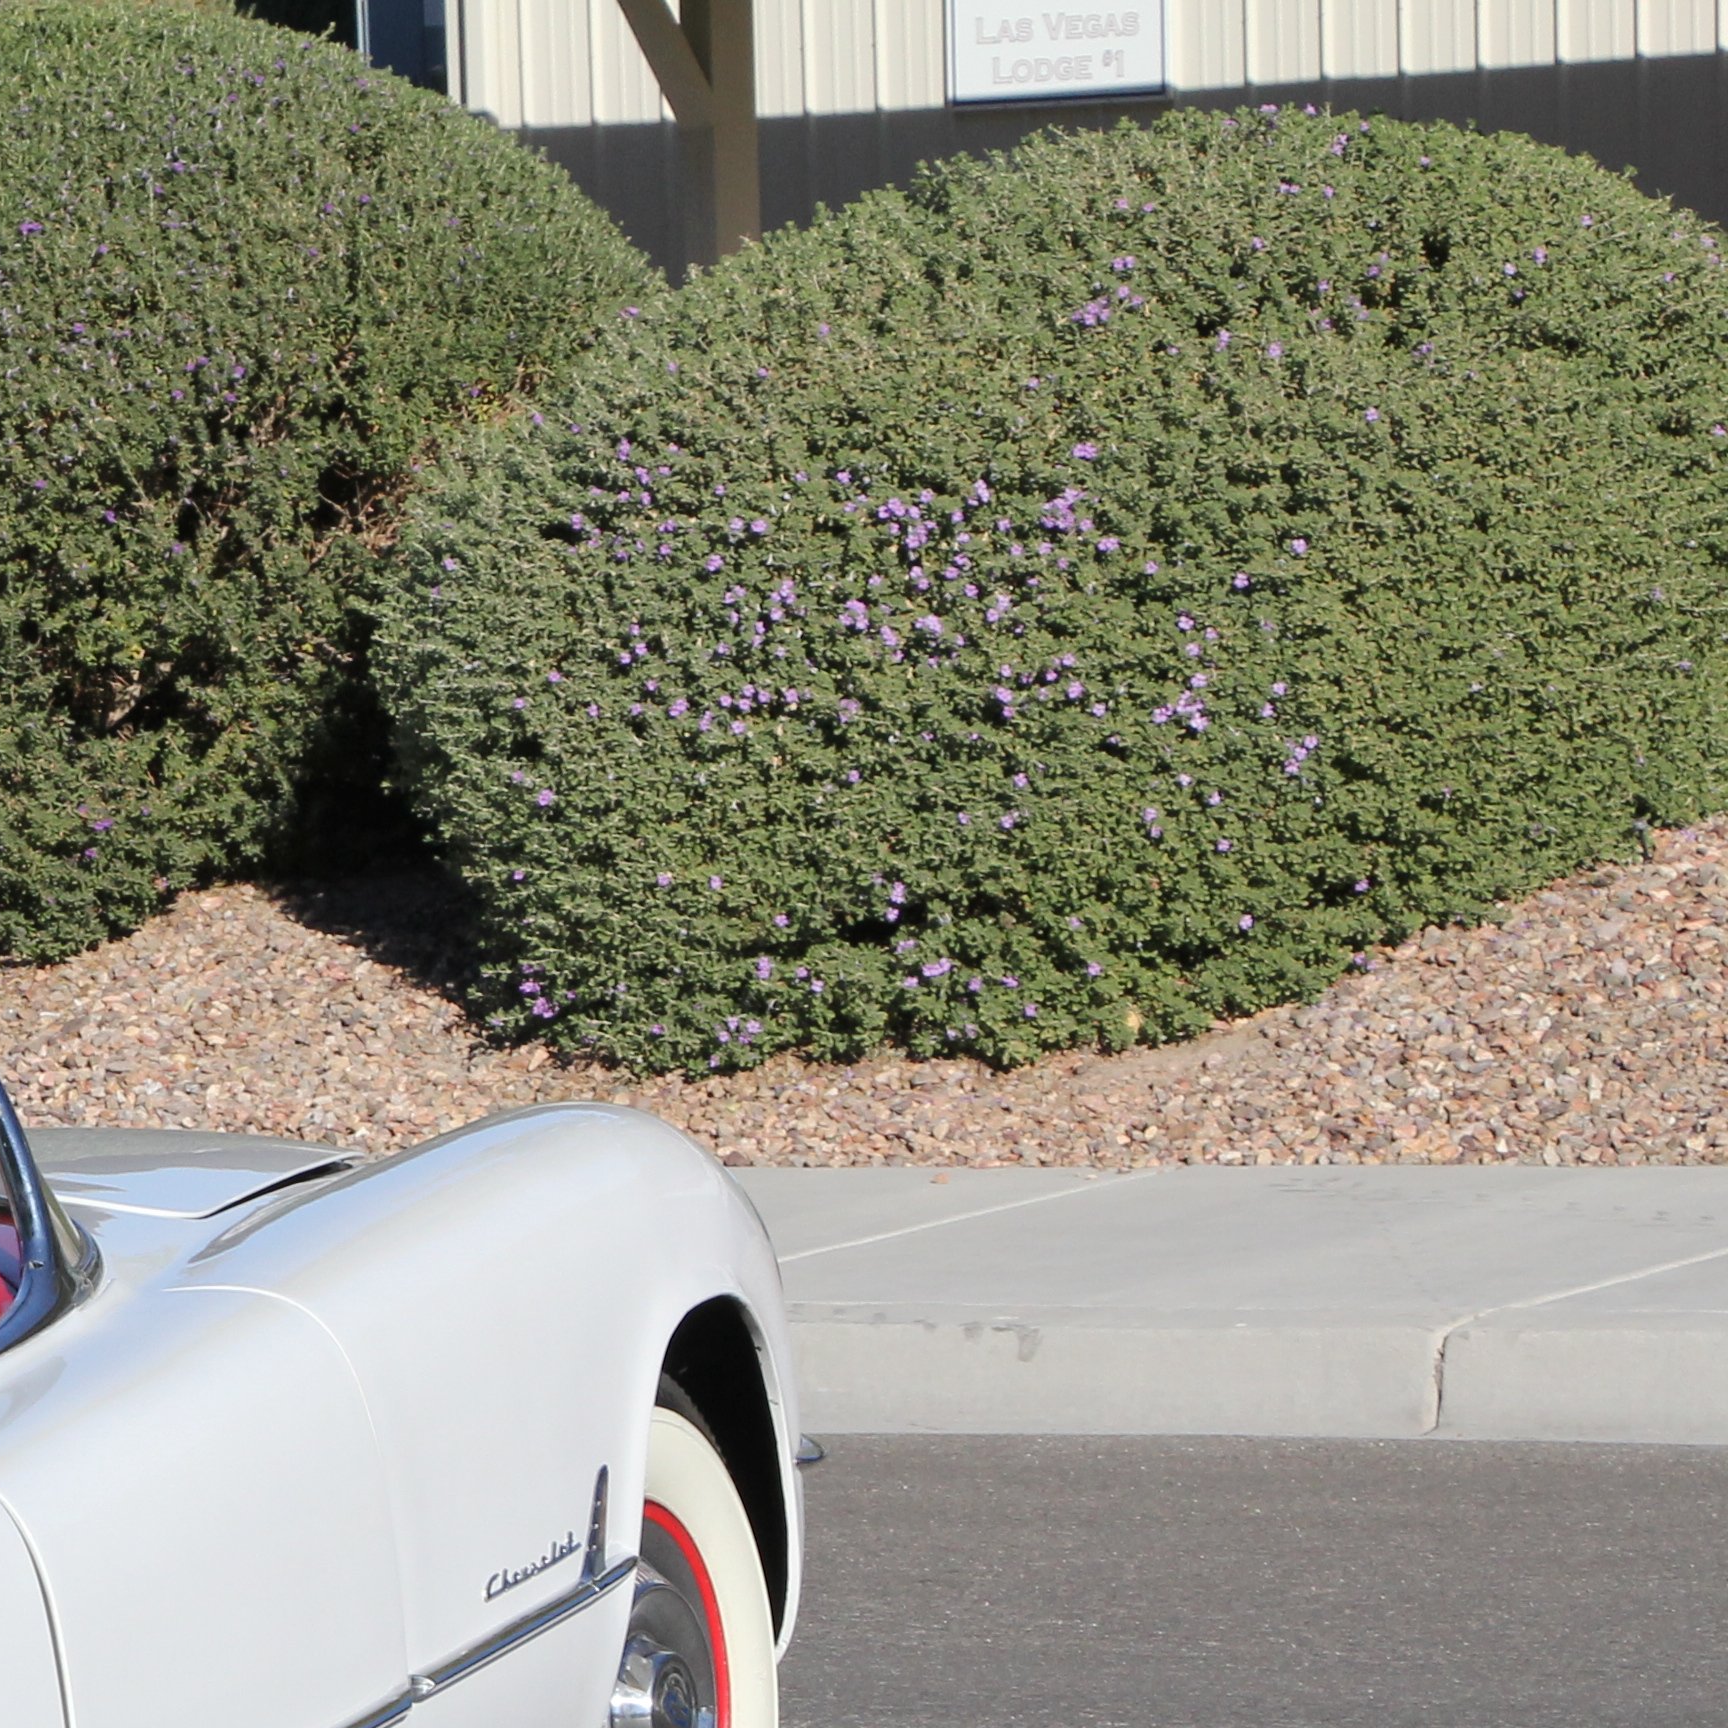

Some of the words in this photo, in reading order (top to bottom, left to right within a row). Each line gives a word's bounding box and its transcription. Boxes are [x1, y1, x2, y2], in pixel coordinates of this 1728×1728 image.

[1042, 12, 1140, 40] VEGAS
[992, 55, 1093, 84] LODGE
[484, 1531, 583, 1602] Chevrolet
